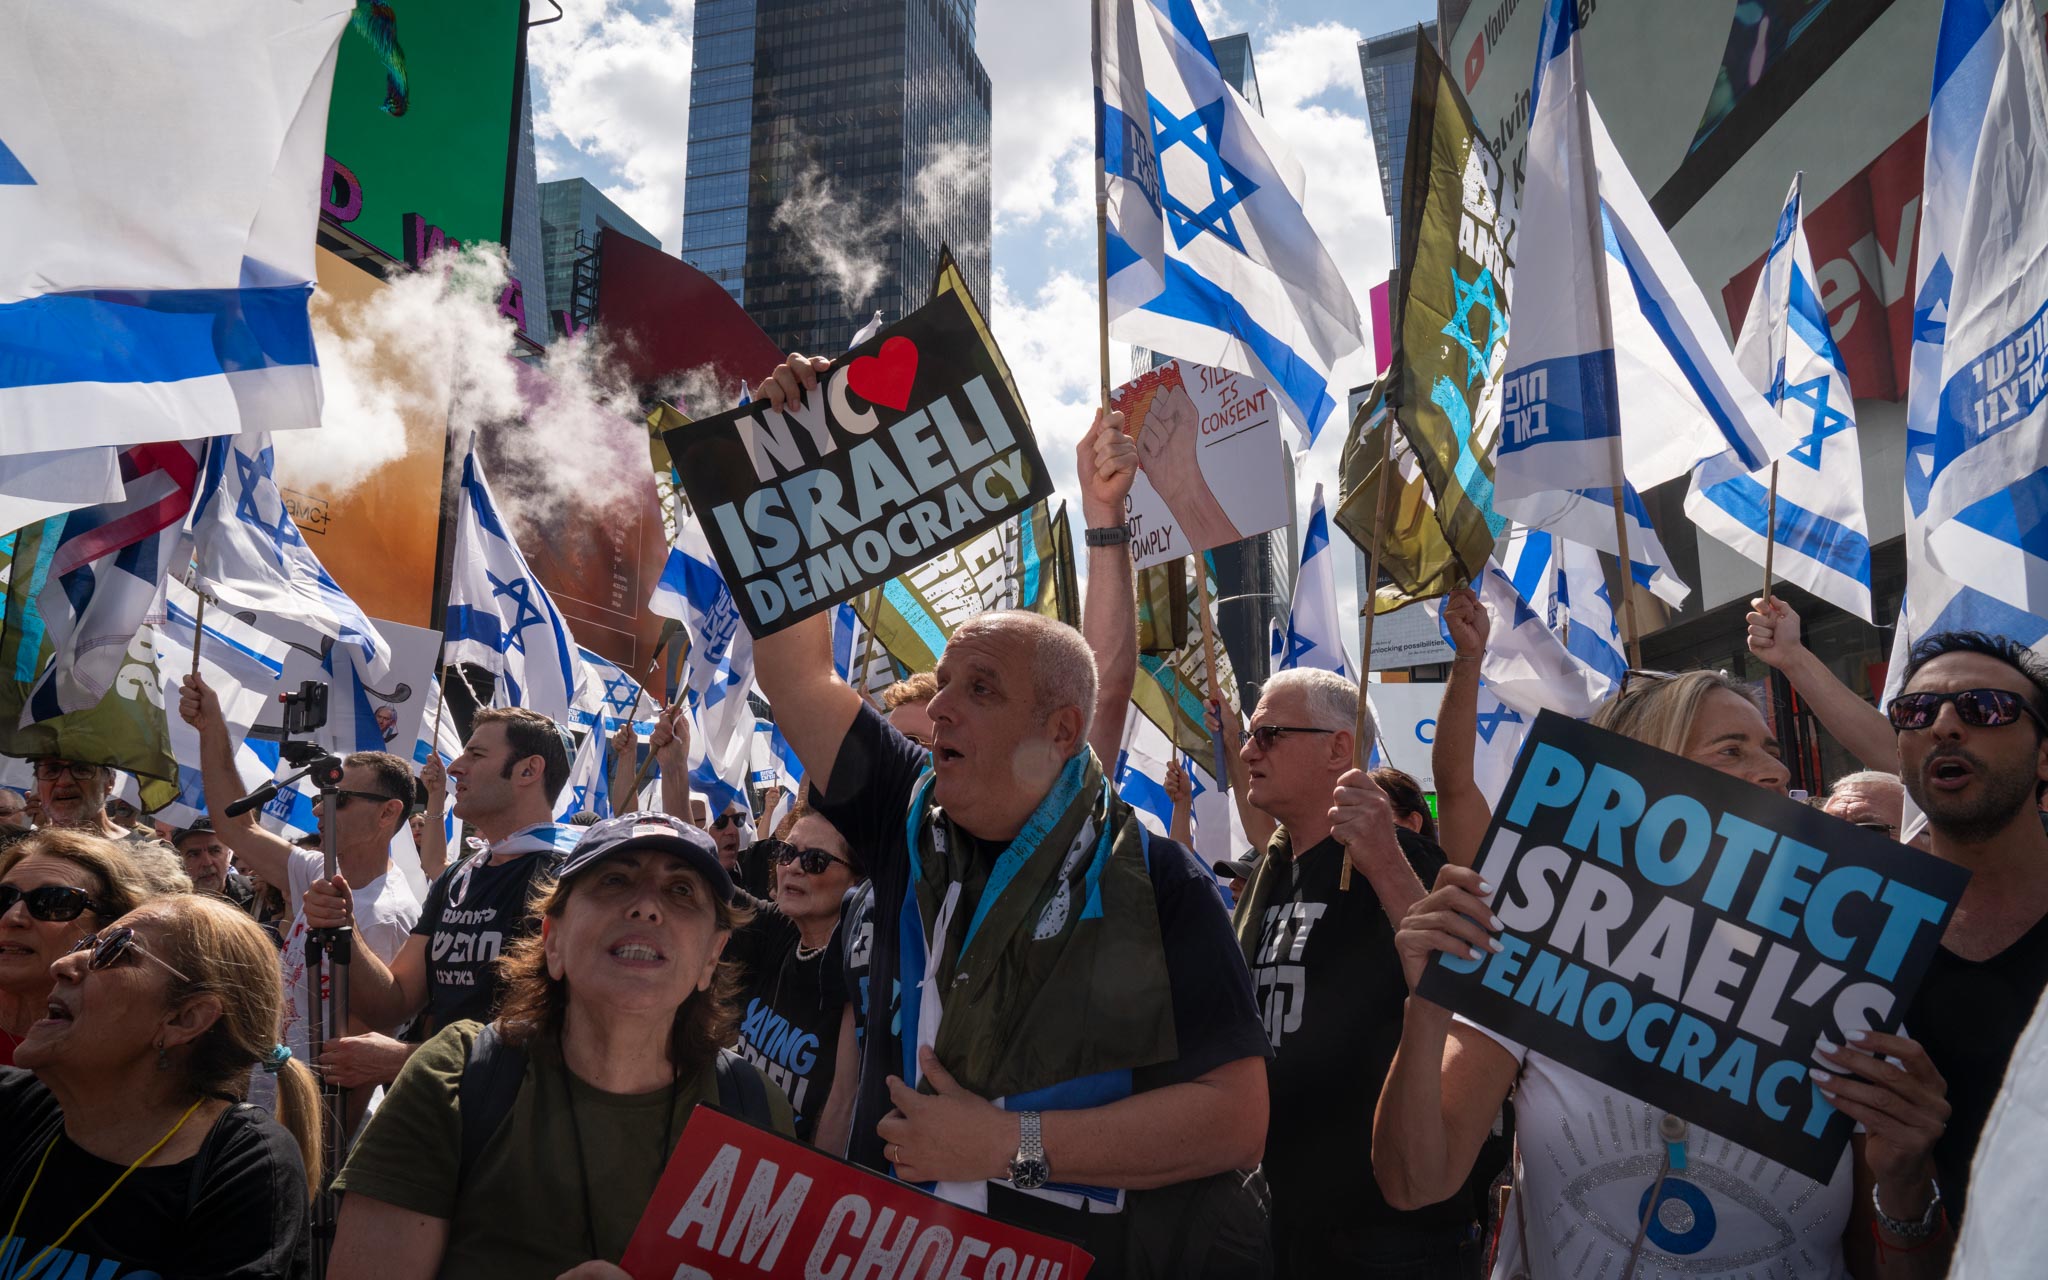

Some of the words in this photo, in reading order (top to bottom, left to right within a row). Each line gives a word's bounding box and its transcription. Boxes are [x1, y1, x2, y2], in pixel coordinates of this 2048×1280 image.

[734, 364, 880, 482] NYC
[1201, 388, 1268, 435] CONSENT
[1218, 380, 1239, 408] IS
[1974, 348, 2048, 435] ארצנו
[712, 374, 1016, 578] ISRAELI
[1128, 514, 1143, 538] OT
[745, 449, 1030, 625] DEMOCRACY
[1132, 524, 1172, 562] OMPLY
[1506, 741, 1948, 983] PROTECT
[666, 1143, 813, 1272] AM
